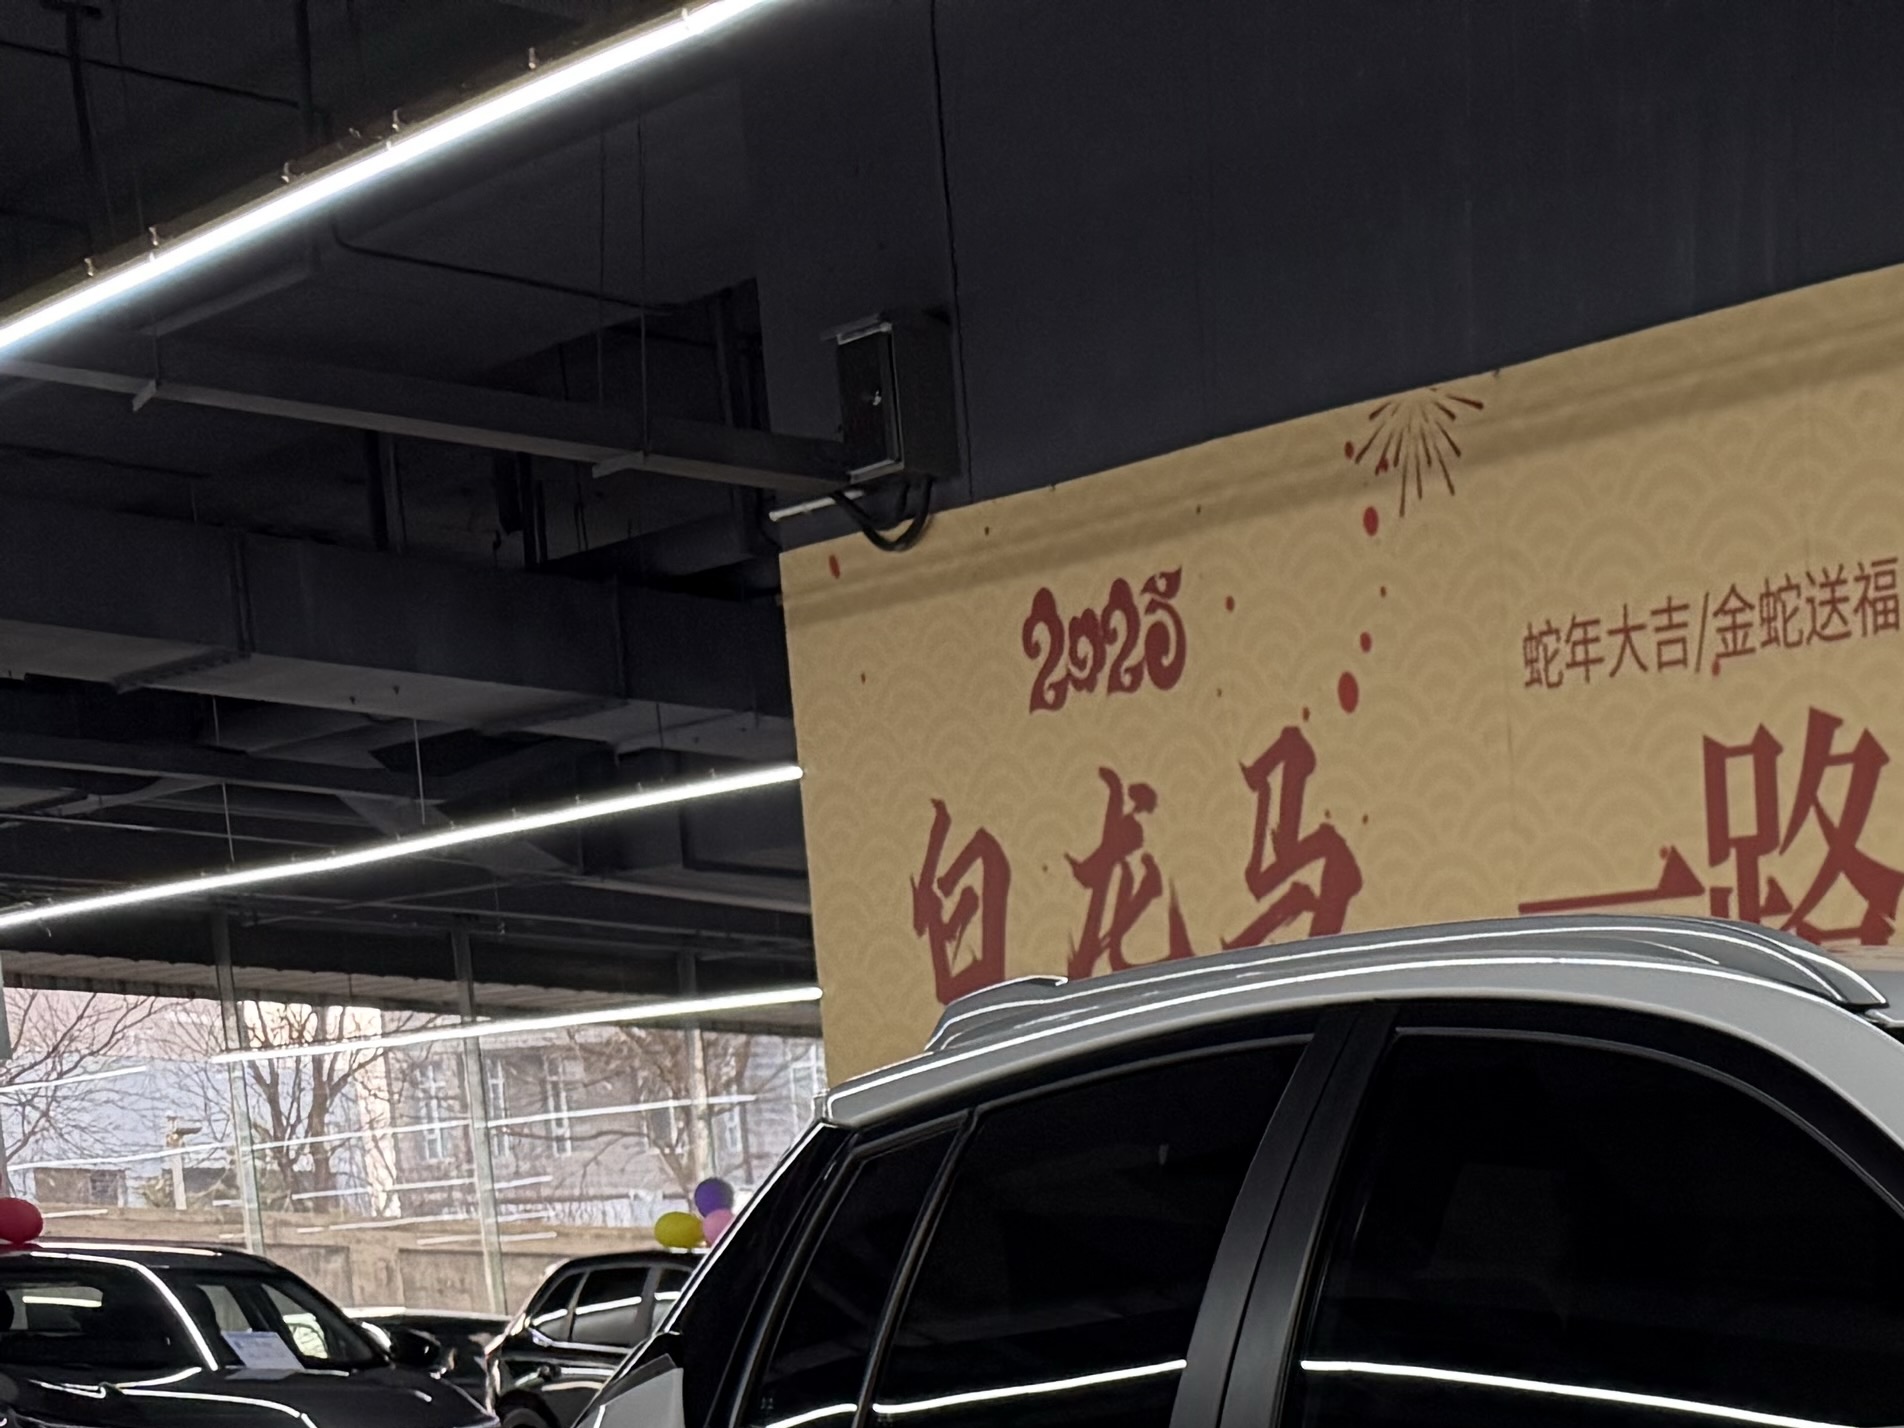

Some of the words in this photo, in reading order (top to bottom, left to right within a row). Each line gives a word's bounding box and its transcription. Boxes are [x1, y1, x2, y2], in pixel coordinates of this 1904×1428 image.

[1021, 565, 1187, 714] 2025
[1523, 556, 1900, 688] 蛇年大吉/金蛇送福
[911, 726, 1363, 1005] 白龙马
